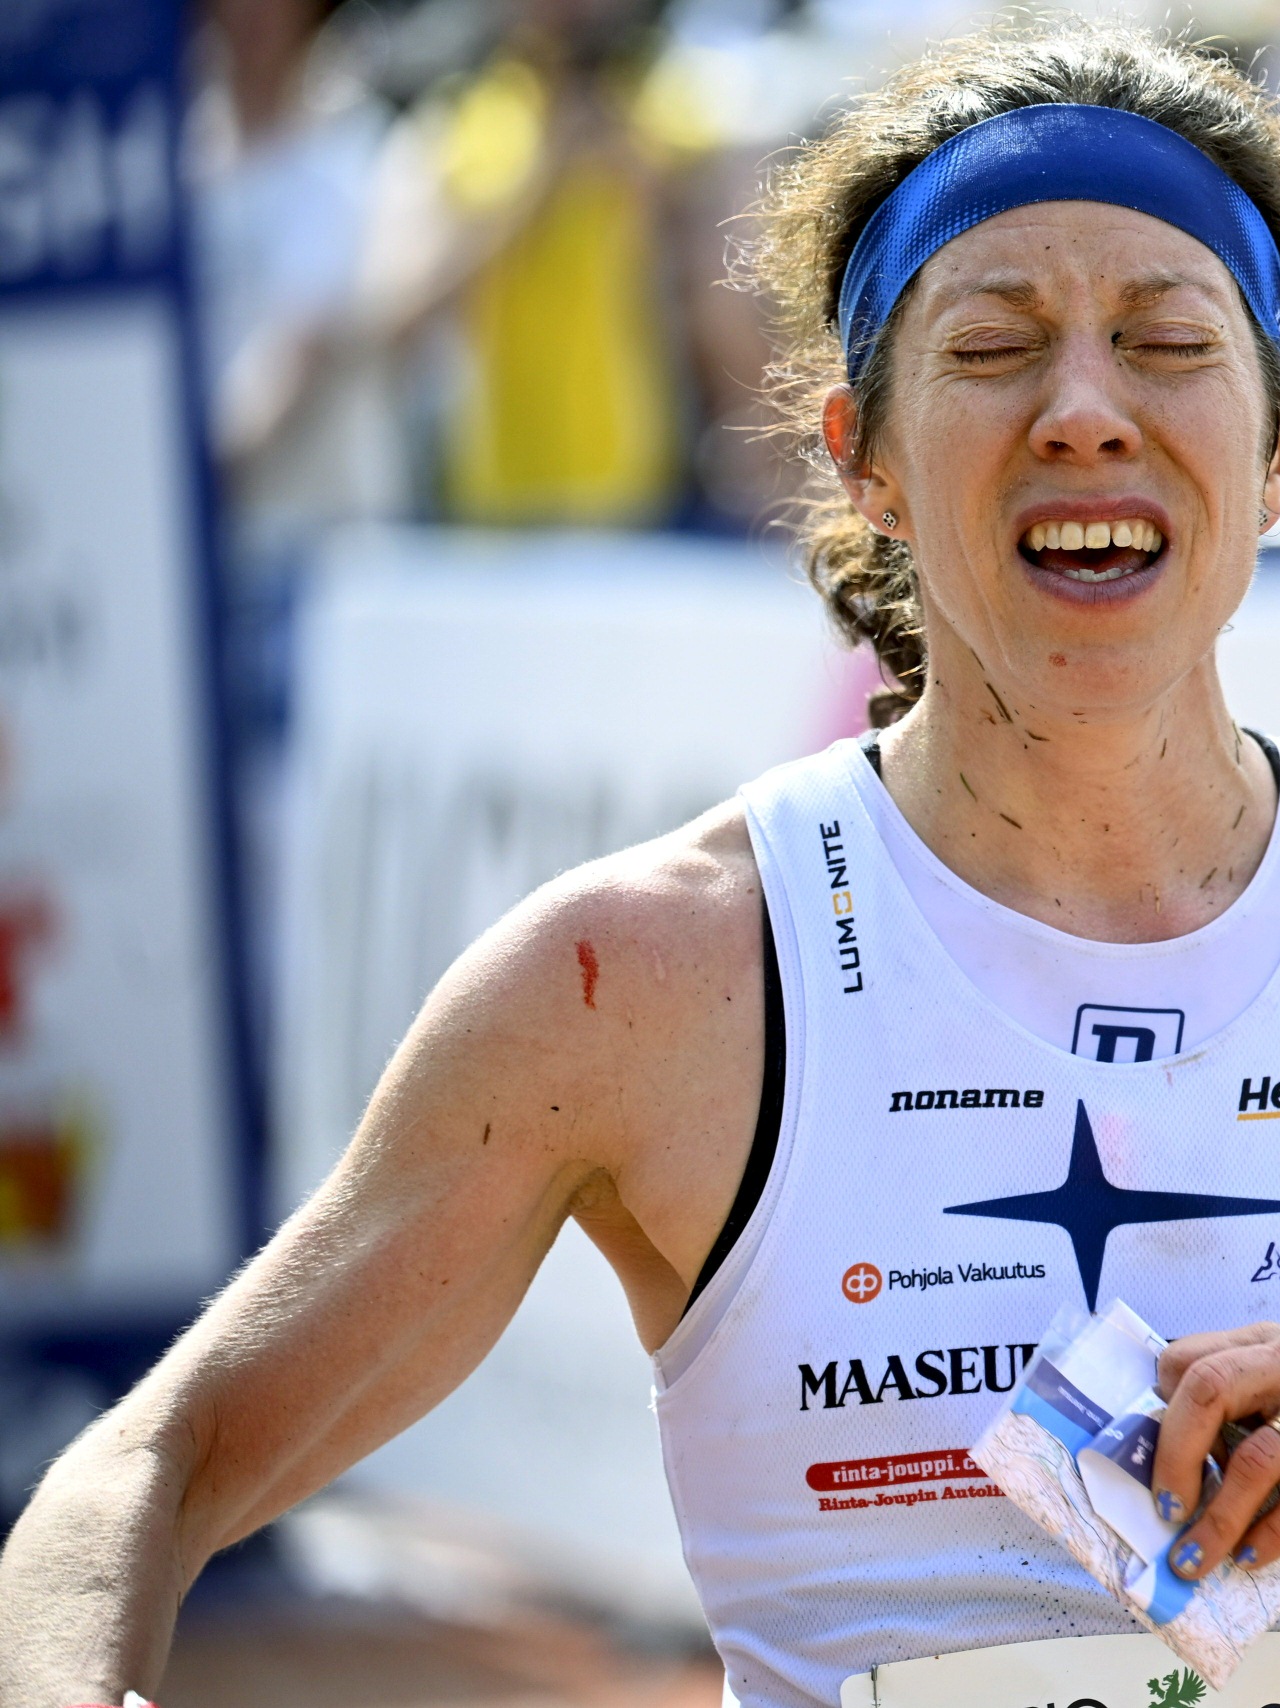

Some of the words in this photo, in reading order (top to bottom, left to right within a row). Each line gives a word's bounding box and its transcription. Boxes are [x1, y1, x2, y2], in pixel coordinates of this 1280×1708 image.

[889, 1088, 1045, 1113] noname
[889, 1266, 954, 1291] Pohjola
[957, 1262, 1046, 1283] Vakuutus
[818, 1489, 938, 1511] Rinta-Joupin
